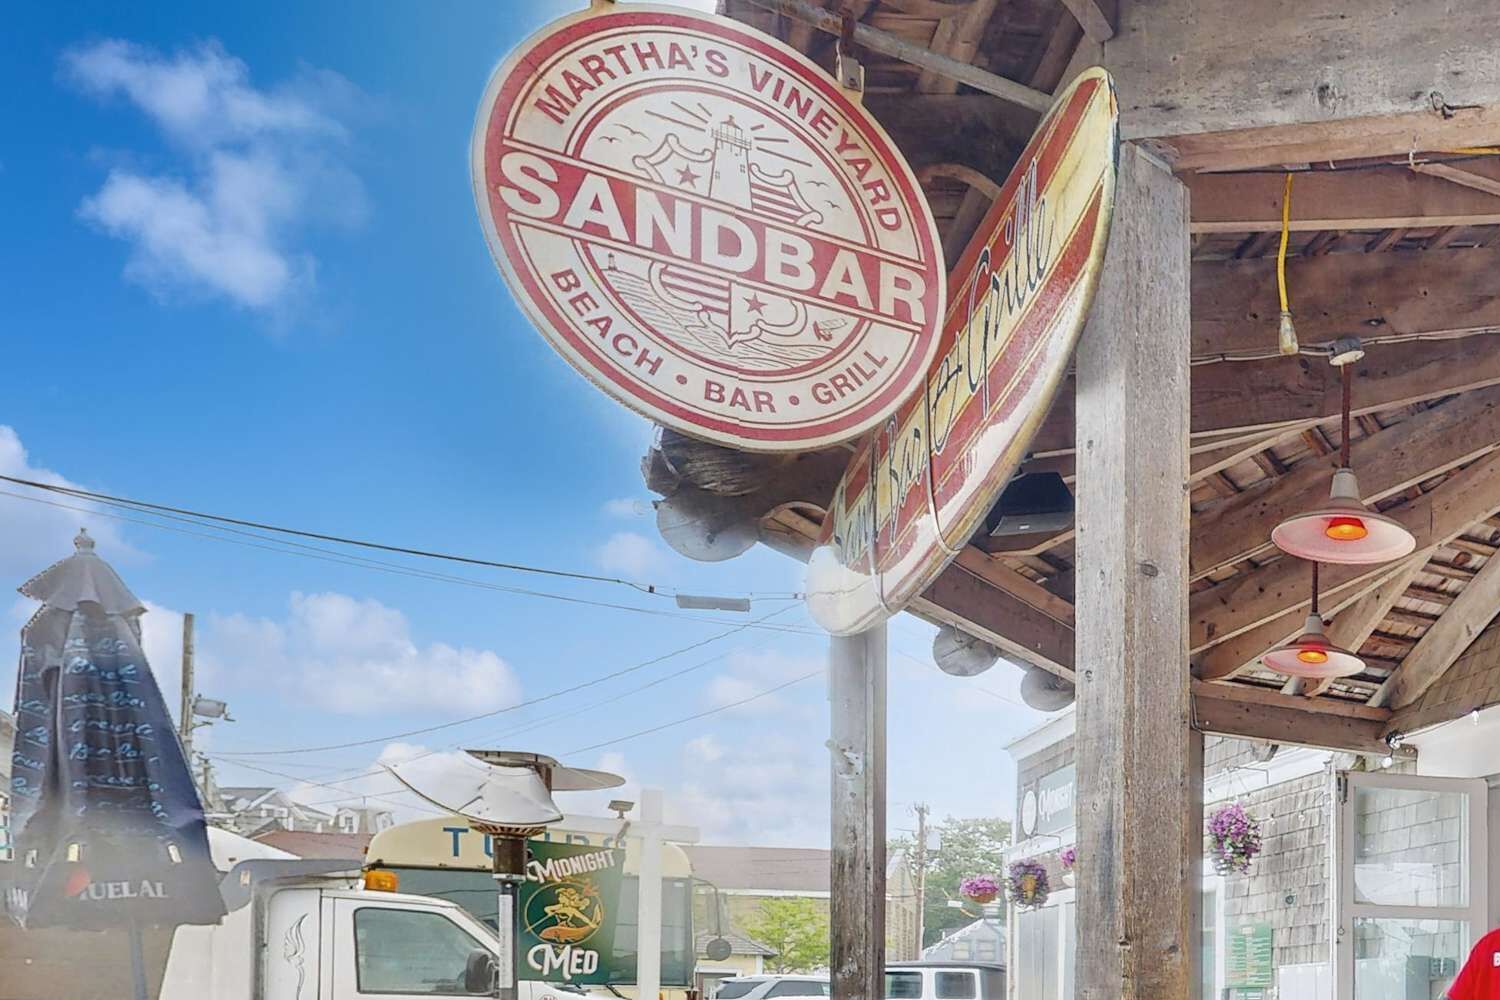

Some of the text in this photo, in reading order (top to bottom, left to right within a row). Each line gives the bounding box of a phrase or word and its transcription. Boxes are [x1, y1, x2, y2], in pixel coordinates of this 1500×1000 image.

[533, 41, 900, 231] MARTHA'S VINEYARD
[499, 152, 926, 326] SANDBAR
[968, 157, 1054, 421] Grille
[551, 268, 889, 413] BEACH BAR GRILL
[526, 849, 616, 884] MIDNIGHT
[527, 944, 599, 980] MED
